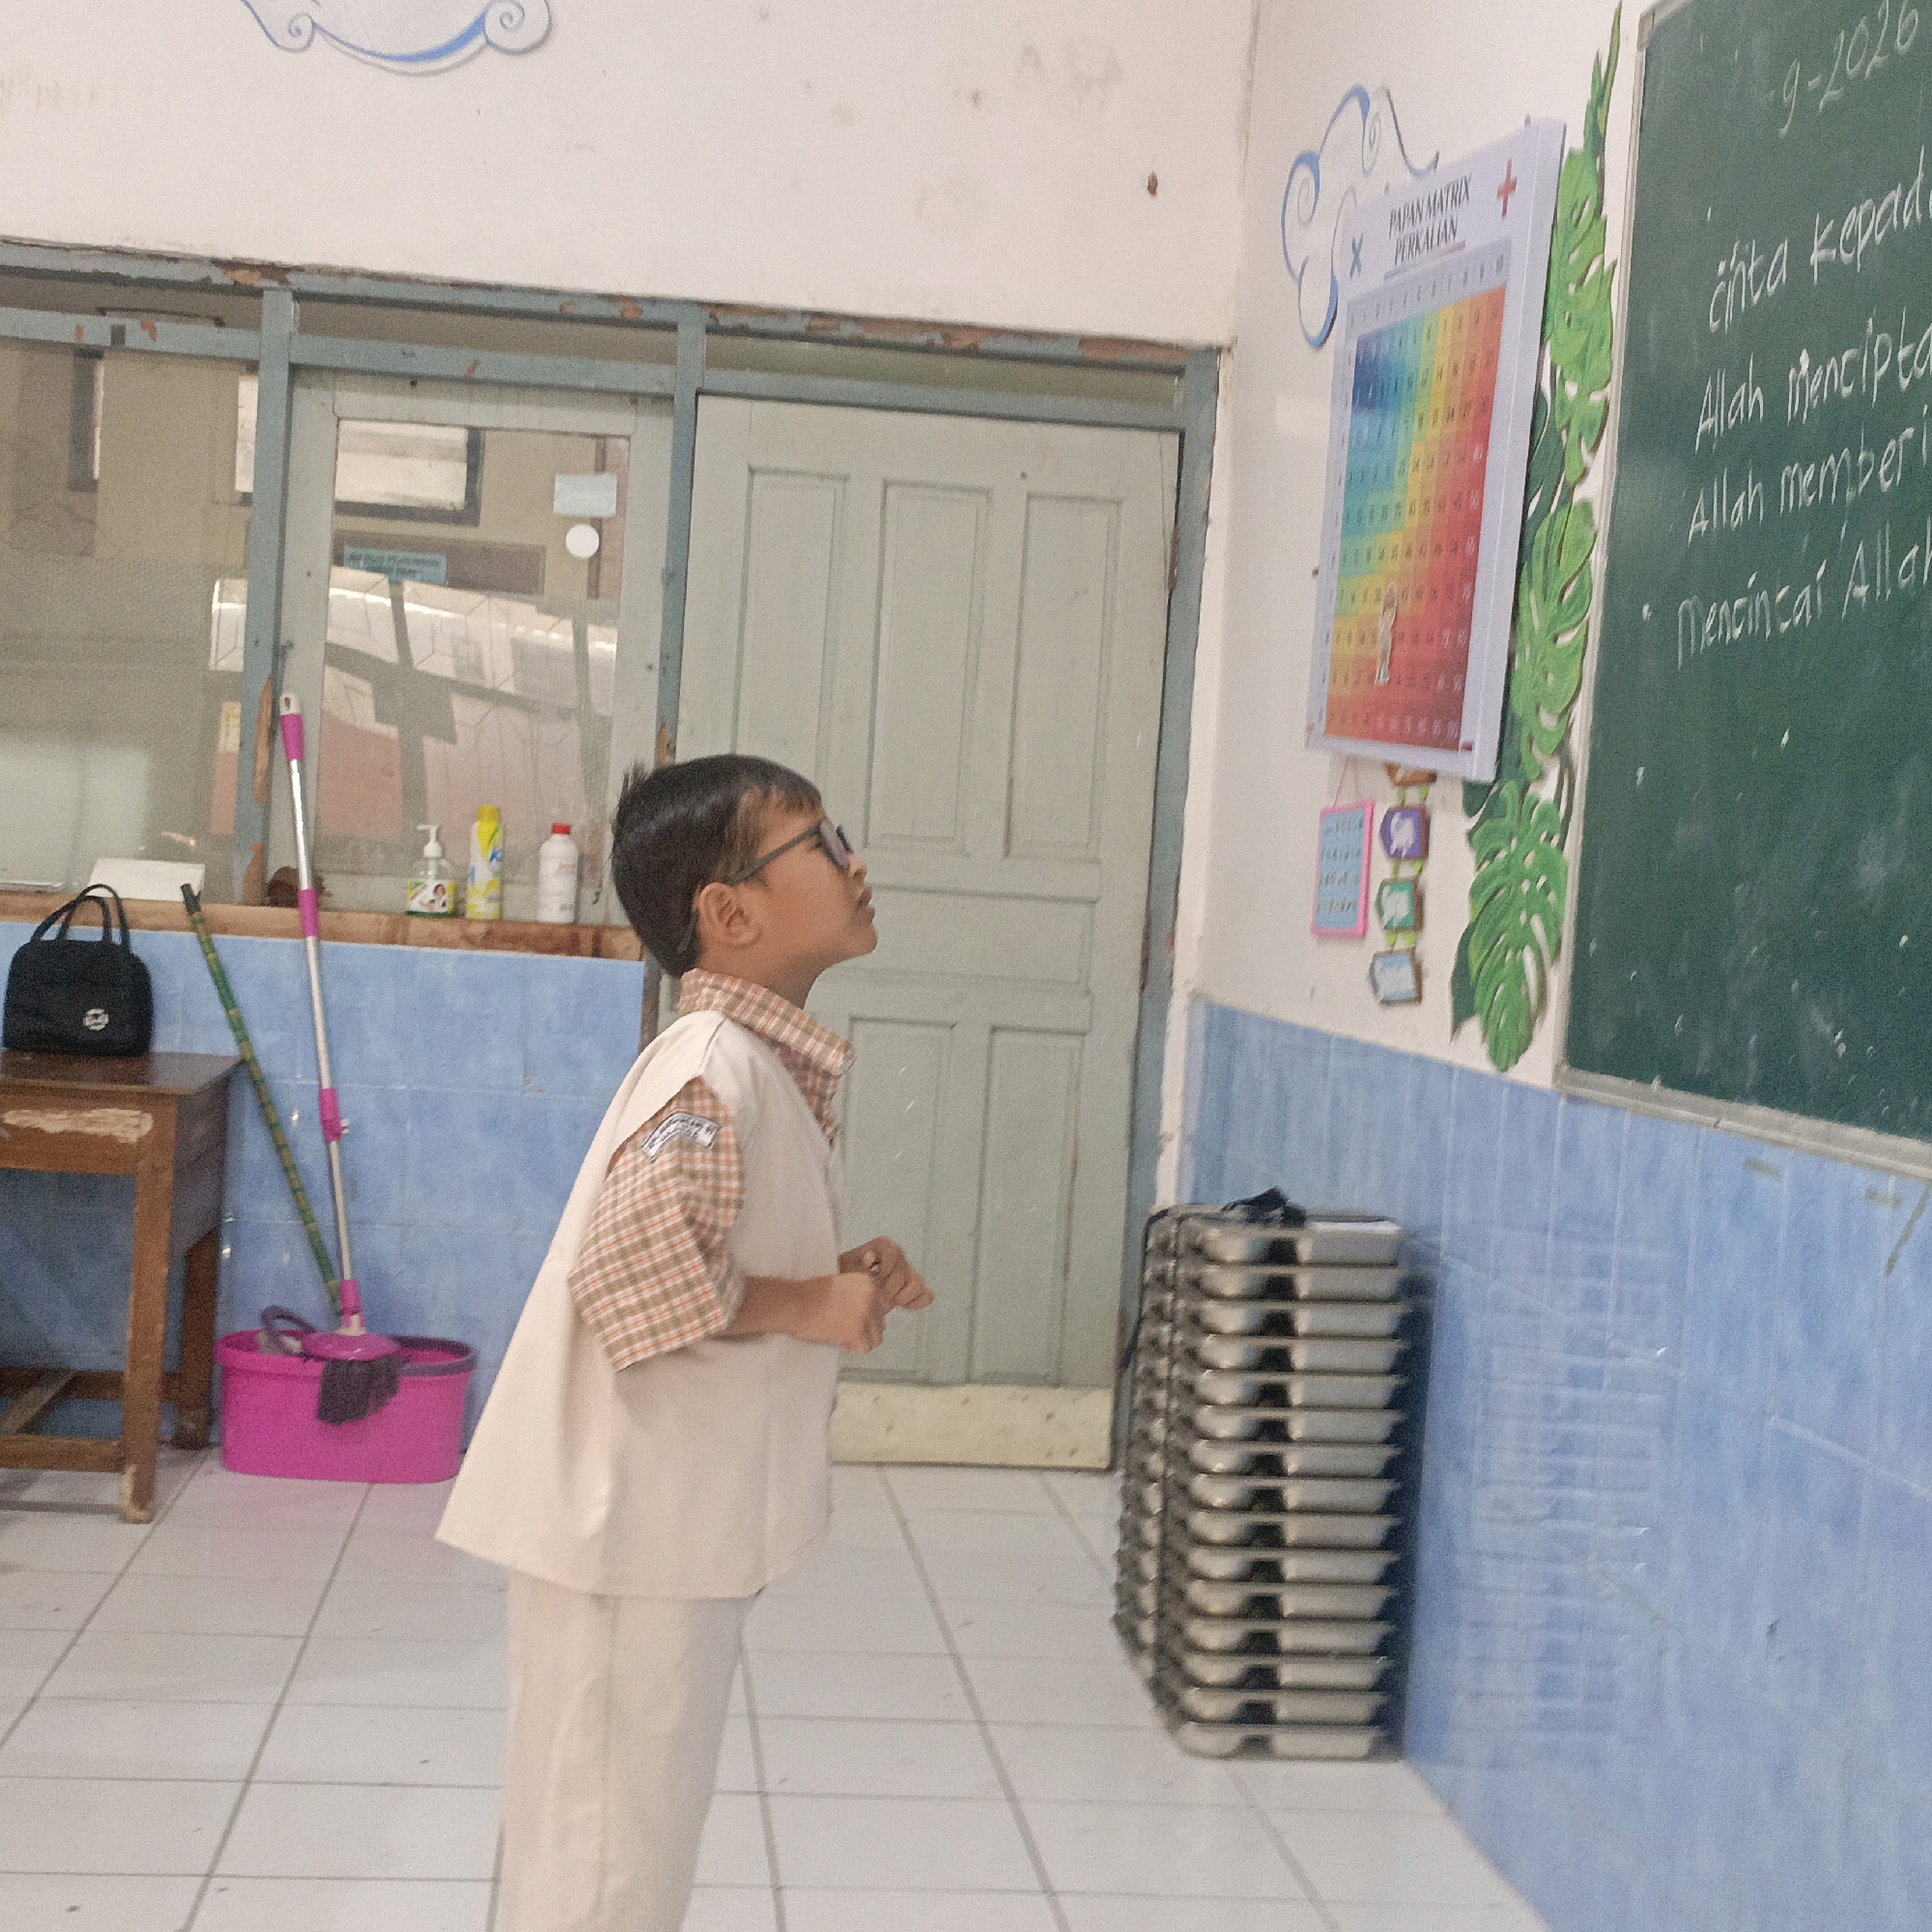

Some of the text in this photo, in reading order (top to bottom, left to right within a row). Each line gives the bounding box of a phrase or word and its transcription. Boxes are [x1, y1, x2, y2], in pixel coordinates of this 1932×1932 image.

[1389, 173, 1472, 241] PAPAN MATRIX
[1394, 212, 1459, 267] PERKALIAN
[1695, 353, 1764, 454] Allah
[1688, 460, 1764, 549] Allah
